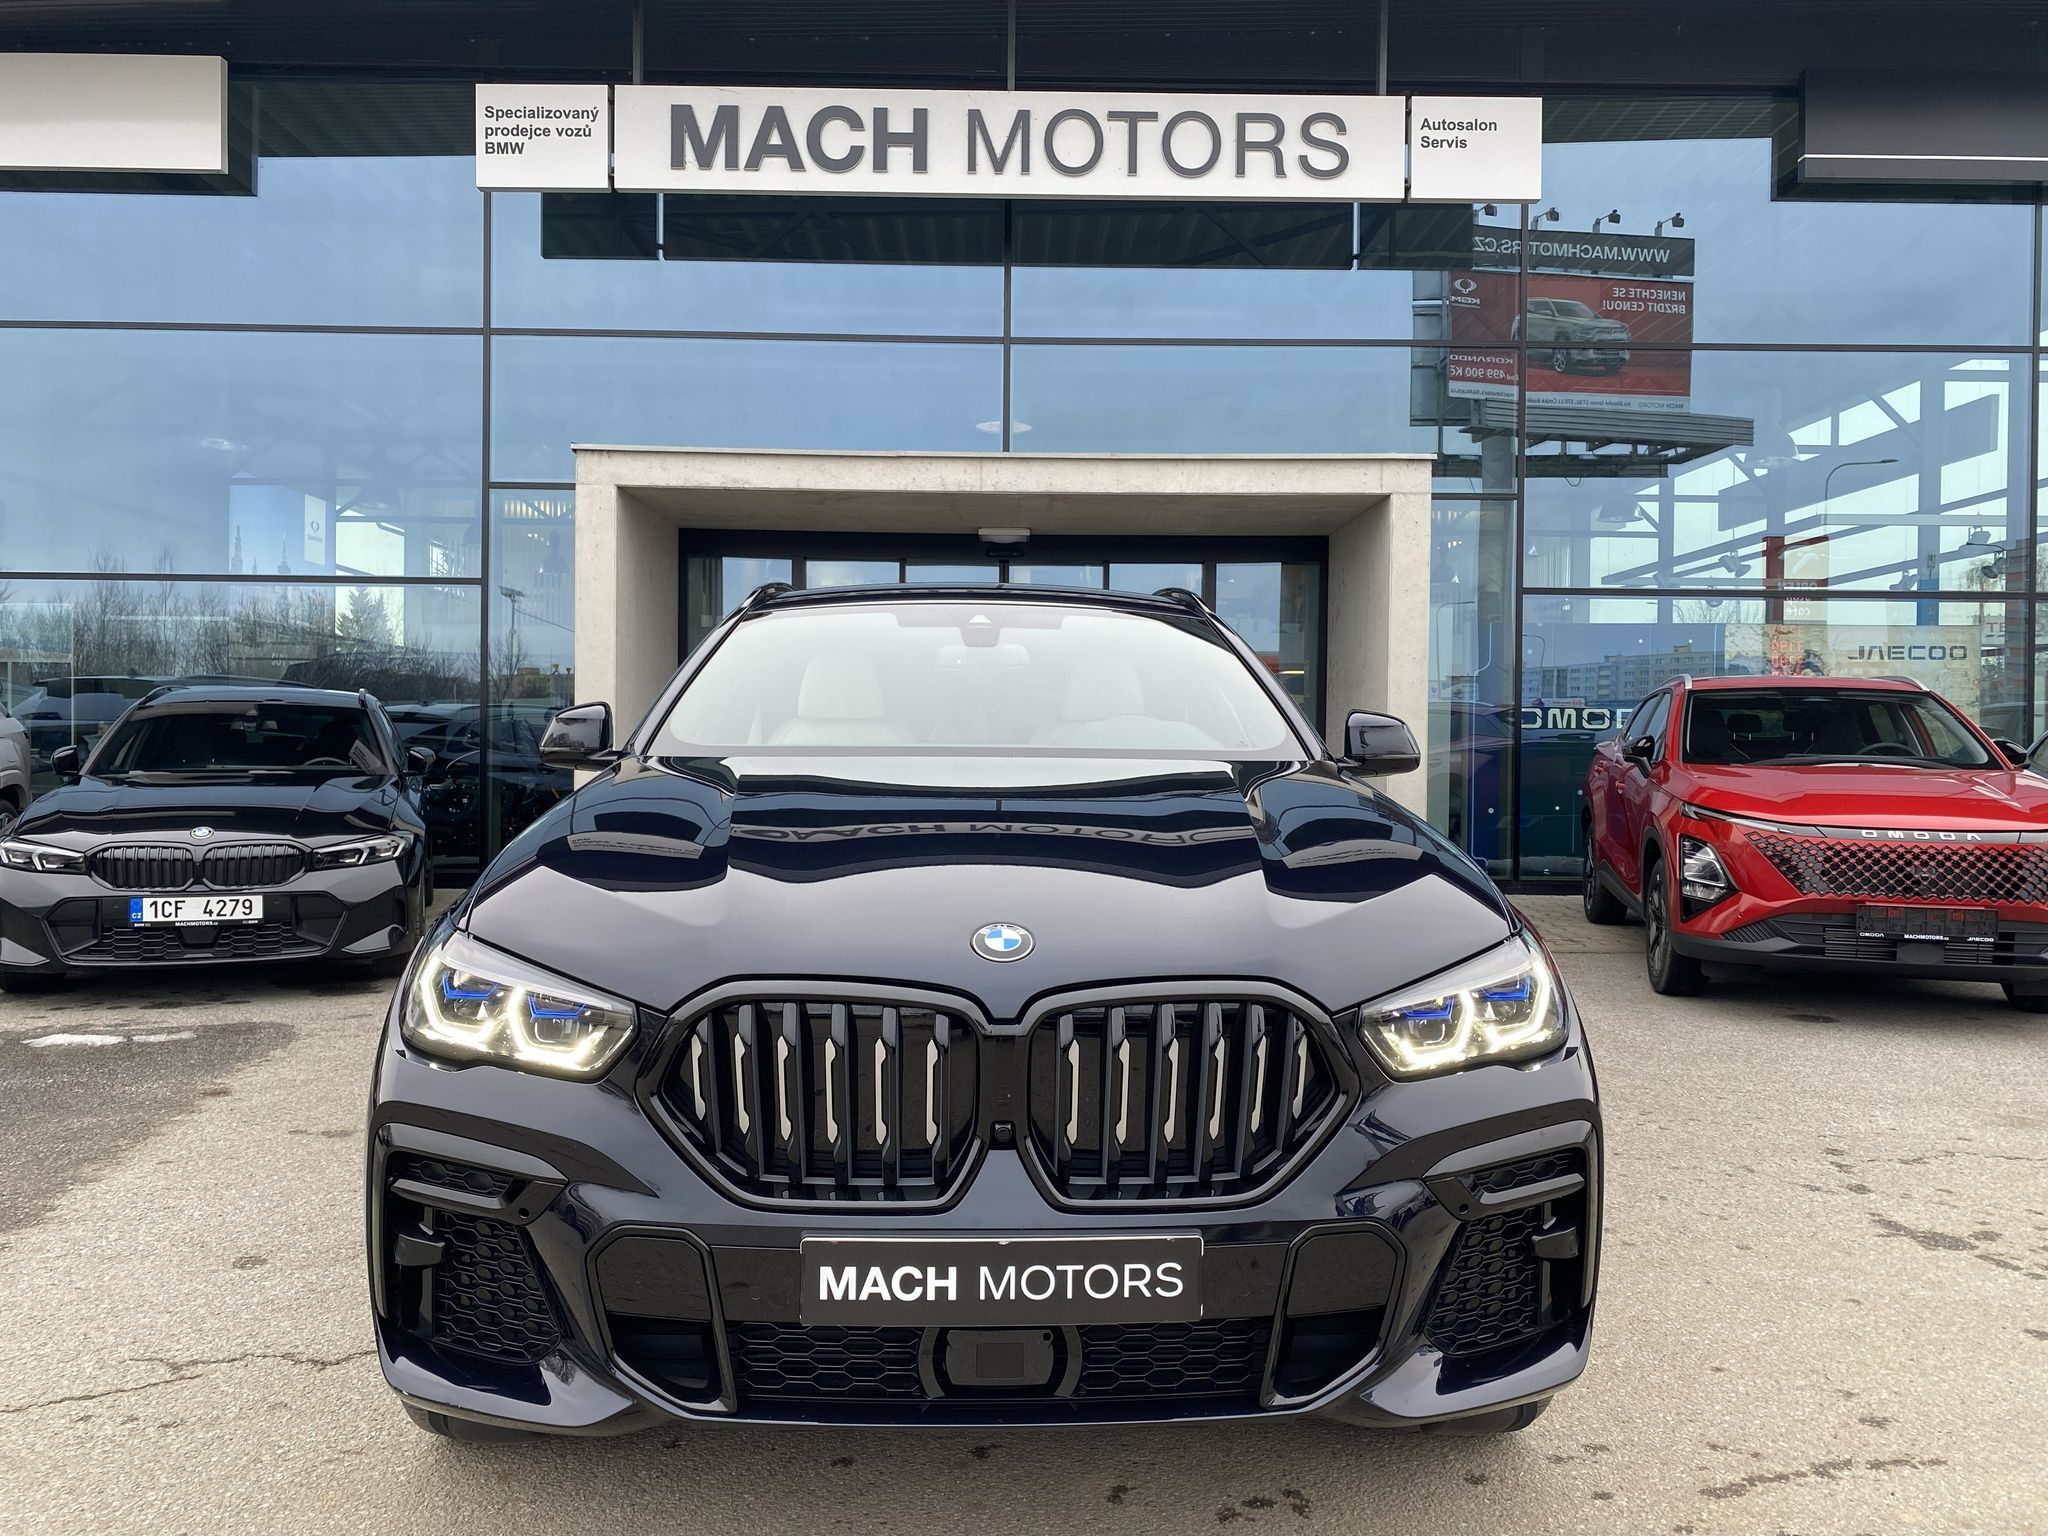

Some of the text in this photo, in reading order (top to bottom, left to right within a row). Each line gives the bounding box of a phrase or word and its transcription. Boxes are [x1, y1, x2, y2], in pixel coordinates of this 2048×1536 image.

[484, 105, 600, 123] Specializovaný
[484, 123, 592, 140] prodejce vozů
[1420, 117, 1498, 132] Autosalon
[484, 141, 525, 155] BMW
[670, 103, 1350, 180] MACH MOTORS
[1420, 135, 1468, 149] Servis
[1847, 645, 1968, 661] JAECOO
[149, 897, 254, 919] 1CF 4279
[818, 1261, 1184, 1302] MACH MOTORS
